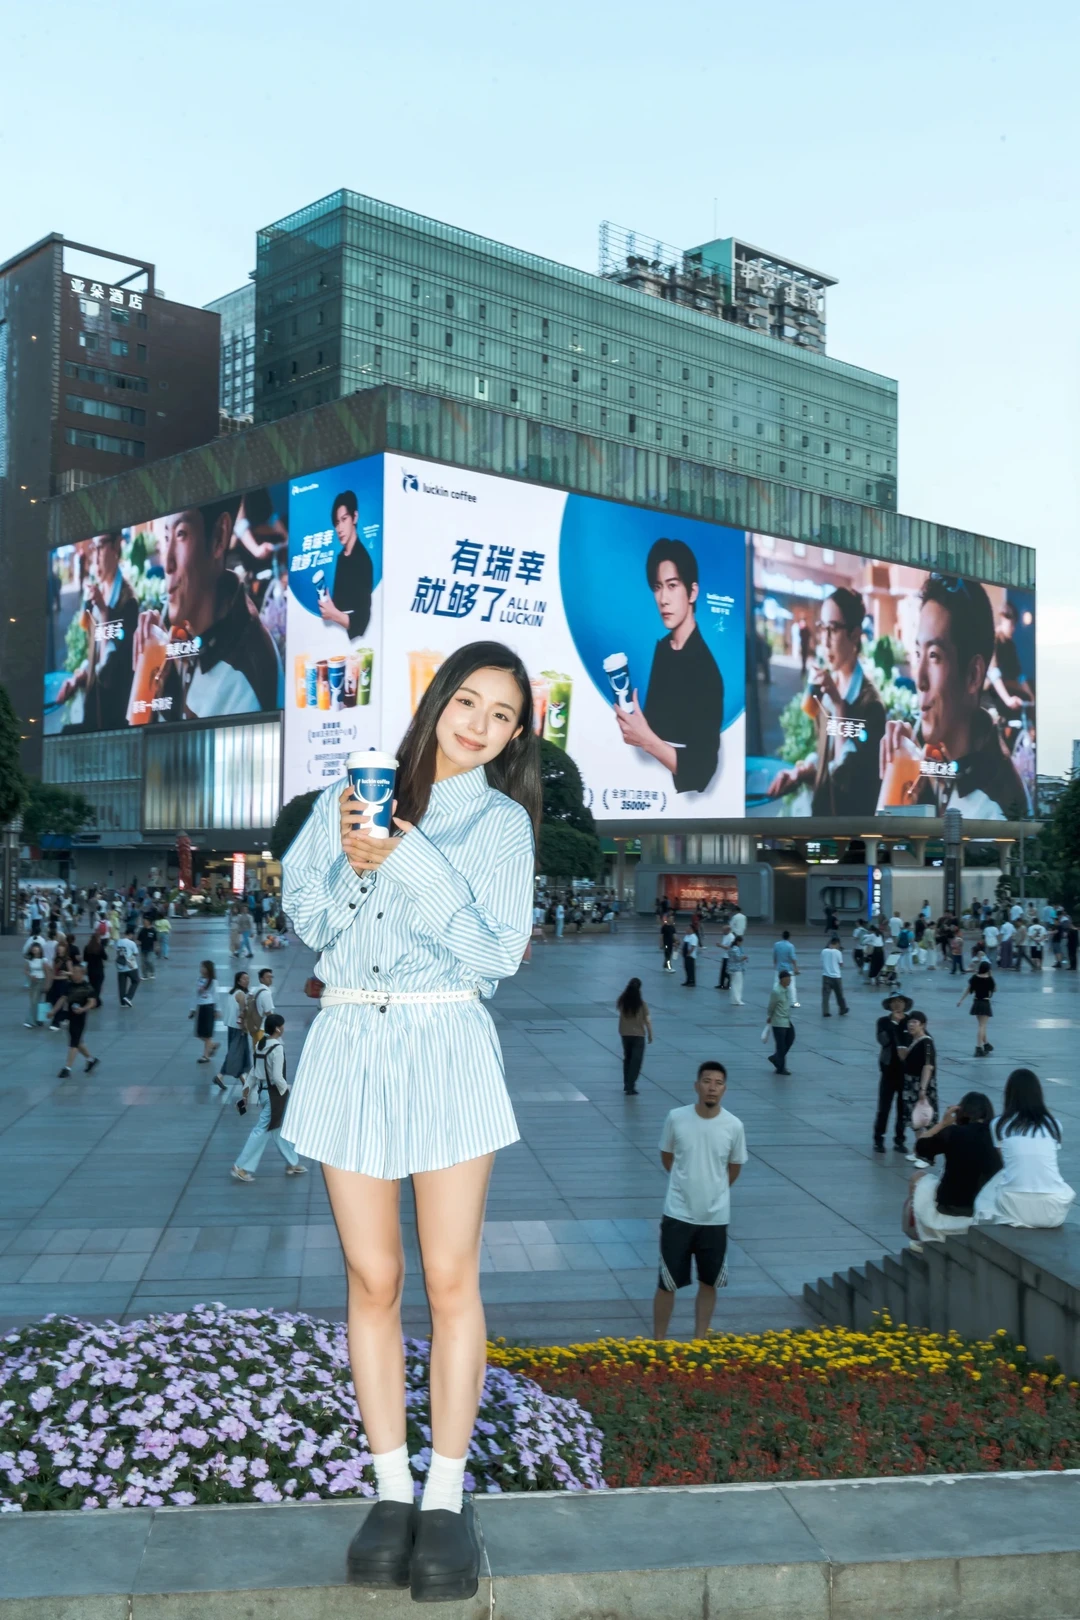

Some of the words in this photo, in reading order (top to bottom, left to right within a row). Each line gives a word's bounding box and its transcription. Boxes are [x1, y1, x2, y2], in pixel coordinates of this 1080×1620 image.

[70, 277, 143, 310] 亚朵酒店
[423, 482, 449, 498] luckin
[451, 490, 477, 503] coffee
[450, 538, 546, 586] 有瑞幸
[410, 575, 507, 623] 就够了
[507, 597, 530, 611] ALL
[533, 600, 548, 614] IN
[499, 610, 545, 627] LUCKIN
[620, 800, 651, 811] 35000+
